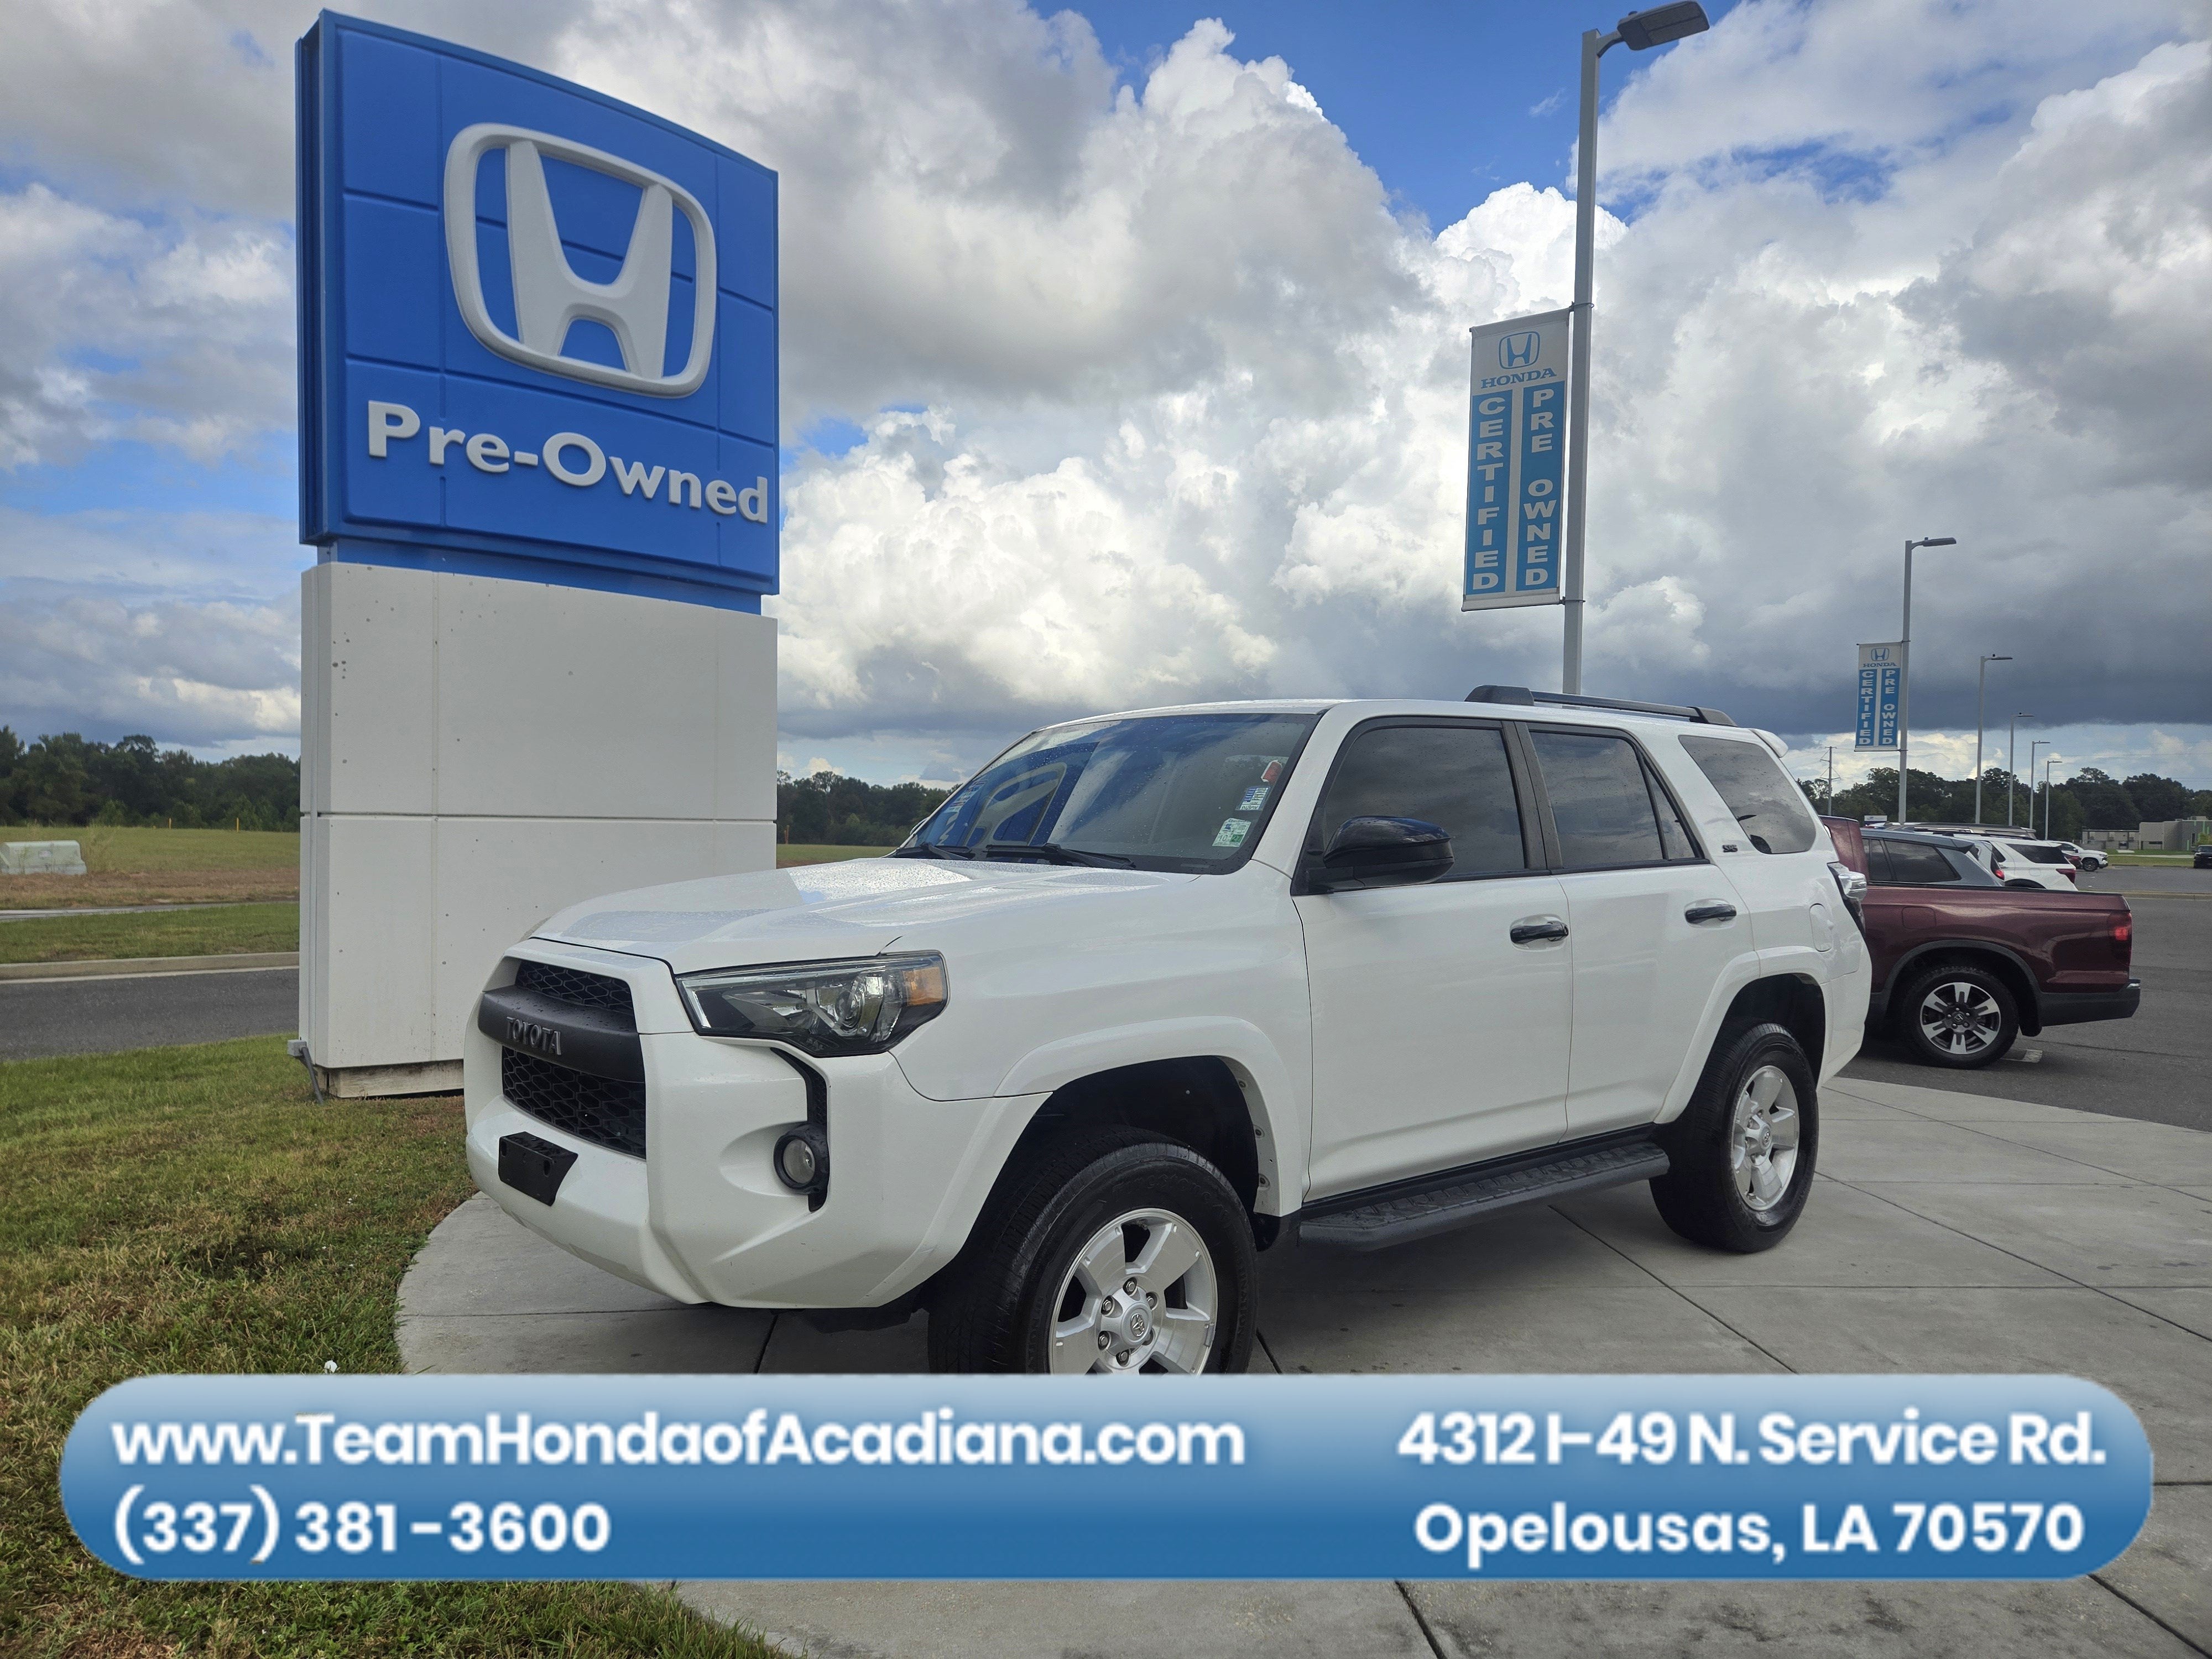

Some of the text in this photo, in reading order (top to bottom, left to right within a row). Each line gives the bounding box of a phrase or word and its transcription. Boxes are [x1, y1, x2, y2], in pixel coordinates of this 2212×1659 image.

[1480, 367, 1557, 388] HONDA
[367, 400, 769, 524] Pre-Owned
[1472, 397, 1506, 590] CERTIFIED
[1523, 388, 1557, 586] PRE OWNED
[1859, 671, 1875, 745] CERTIFIED
[1881, 670, 1897, 744] PRE OWNED
[506, 1016, 562, 1056] TOYOTA
